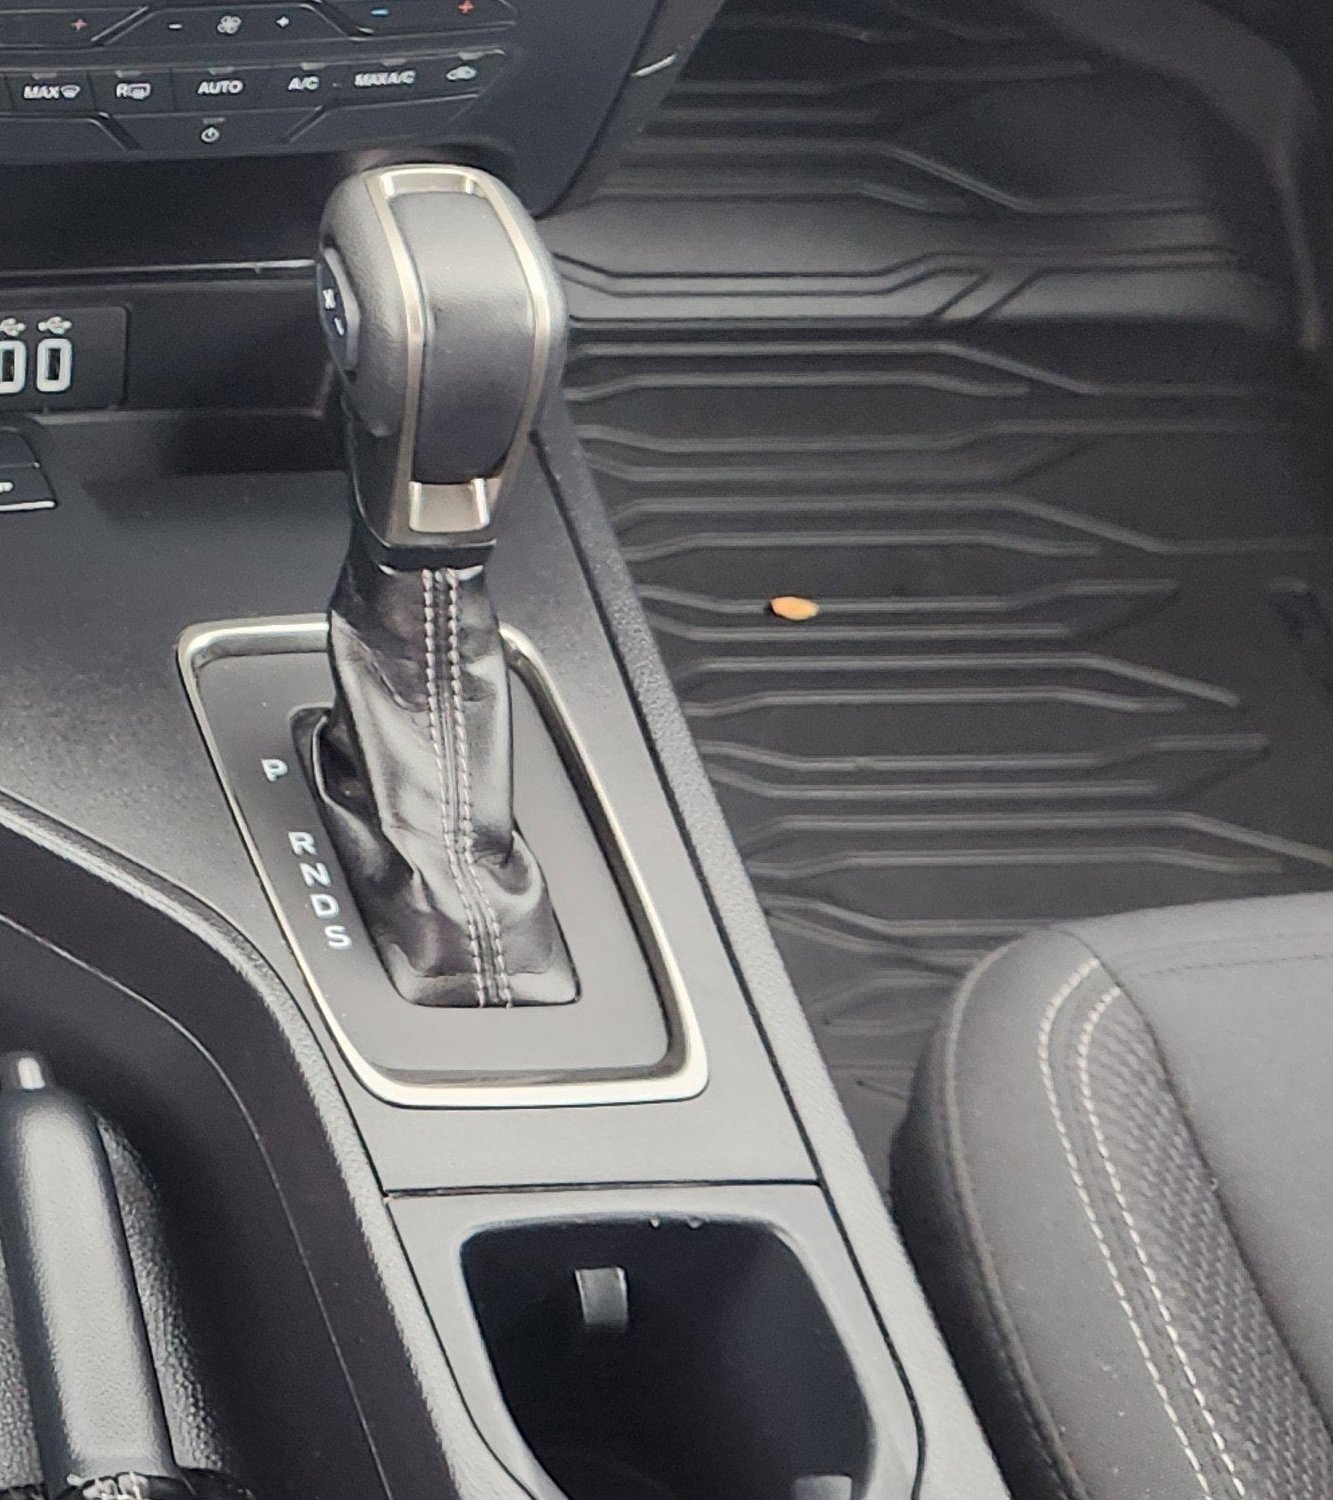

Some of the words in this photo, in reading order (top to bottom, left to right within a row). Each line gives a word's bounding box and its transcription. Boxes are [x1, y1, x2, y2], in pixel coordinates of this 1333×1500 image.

[196, 79, 244, 95] AUTO
[286, 76, 321, 92] A/C
[260, 757, 289, 783] P
[287, 830, 318, 857] R
[299, 861, 332, 888] N
[310, 893, 340, 920] D
[324, 924, 353, 950] S
